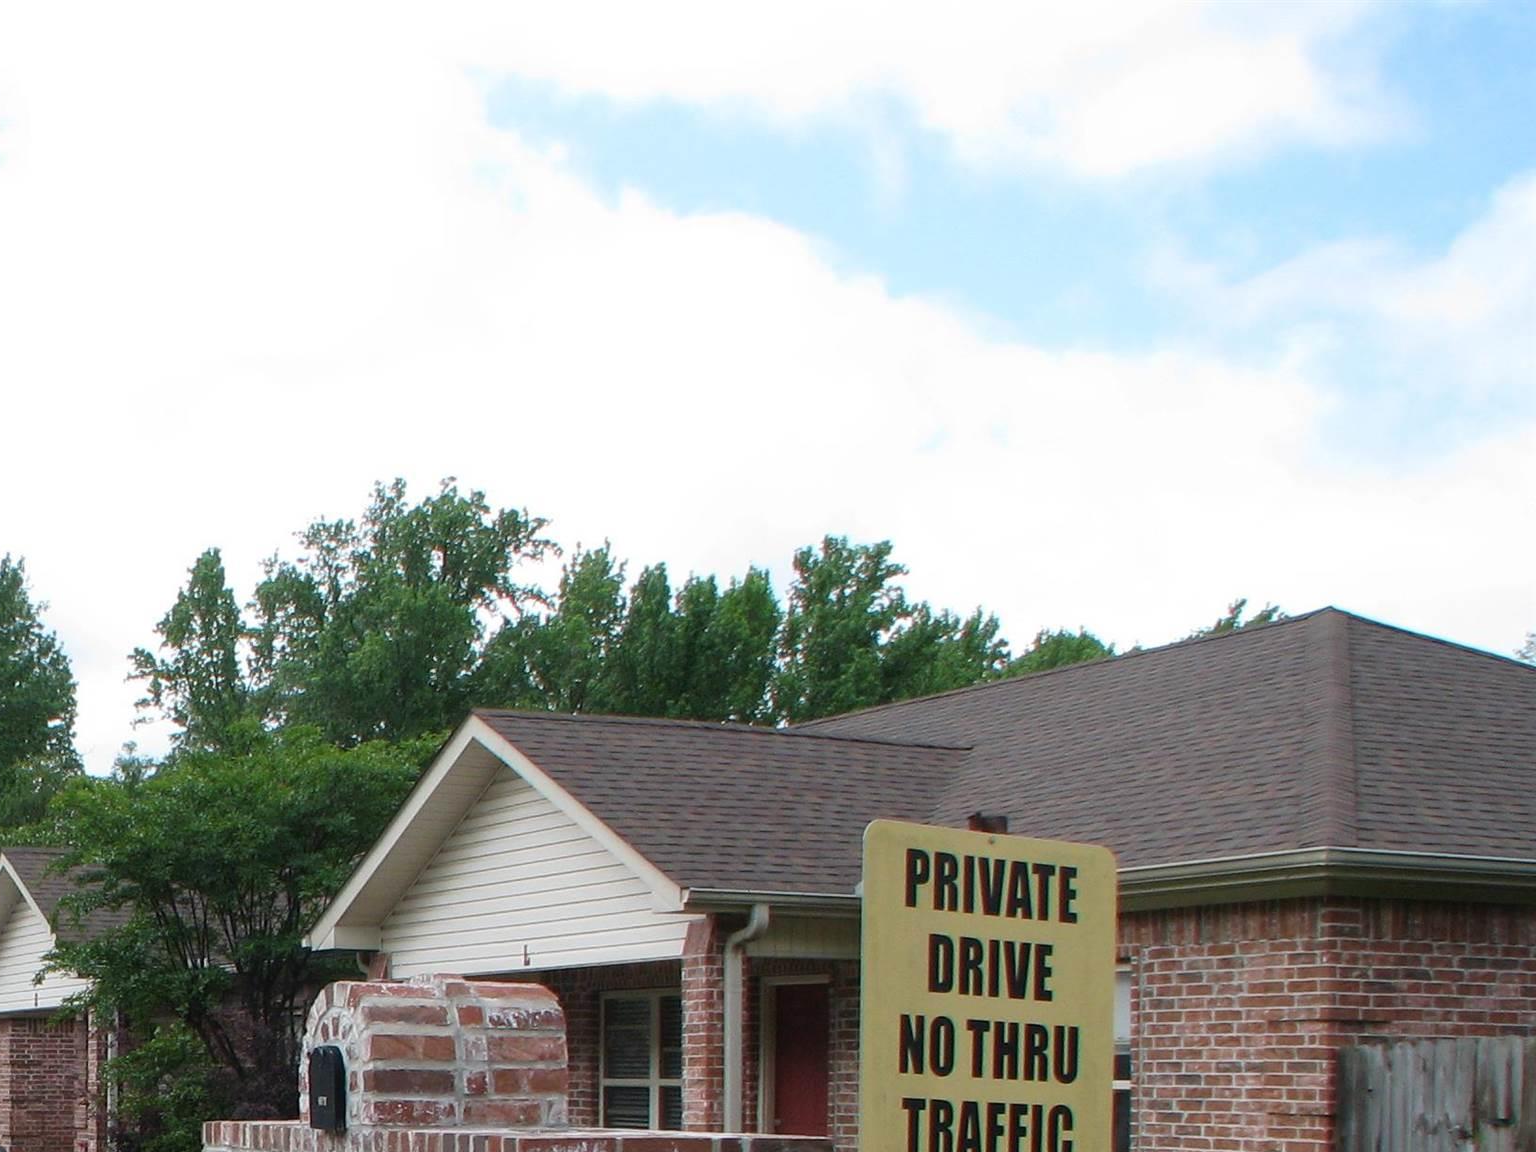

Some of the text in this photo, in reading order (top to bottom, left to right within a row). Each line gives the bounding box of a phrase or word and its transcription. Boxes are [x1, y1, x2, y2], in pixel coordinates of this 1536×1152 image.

[905, 848, 1077, 924] PRIVATE
[928, 933, 1053, 1002] DRIVE
[899, 1014, 1079, 1084] NO THRU
